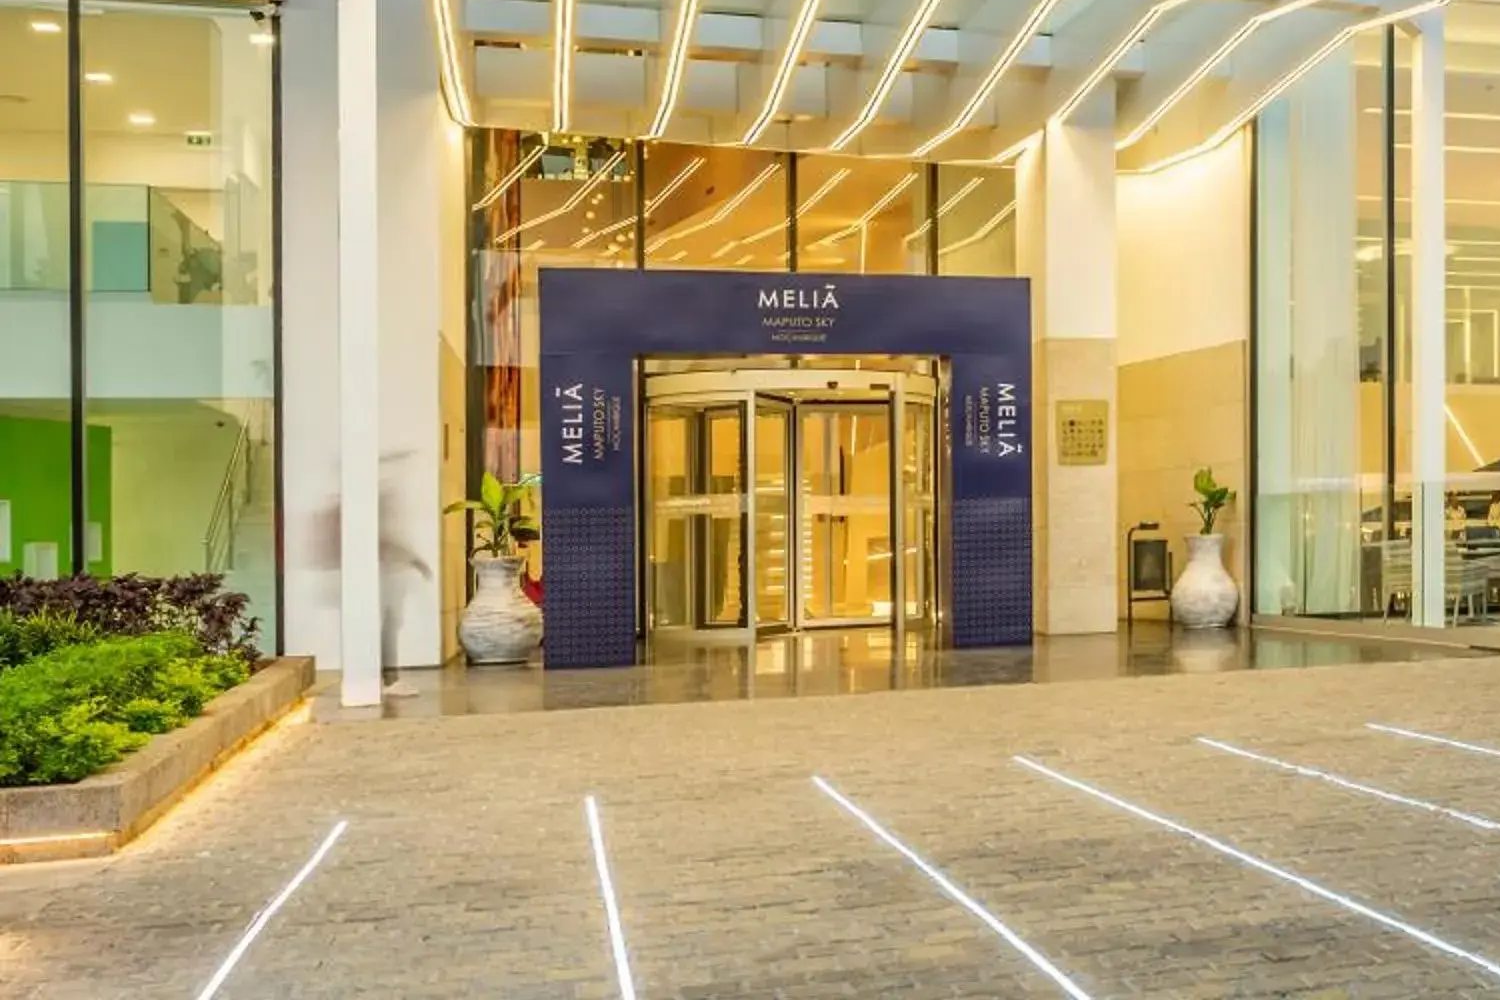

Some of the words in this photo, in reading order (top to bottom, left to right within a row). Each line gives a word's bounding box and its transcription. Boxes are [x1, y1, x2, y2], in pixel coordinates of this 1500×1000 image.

[762, 317, 811, 328] MAPUTO
[815, 317, 836, 328] SKY
[592, 387, 605, 407] SKY
[592, 409, 605, 461] MAPUTO
